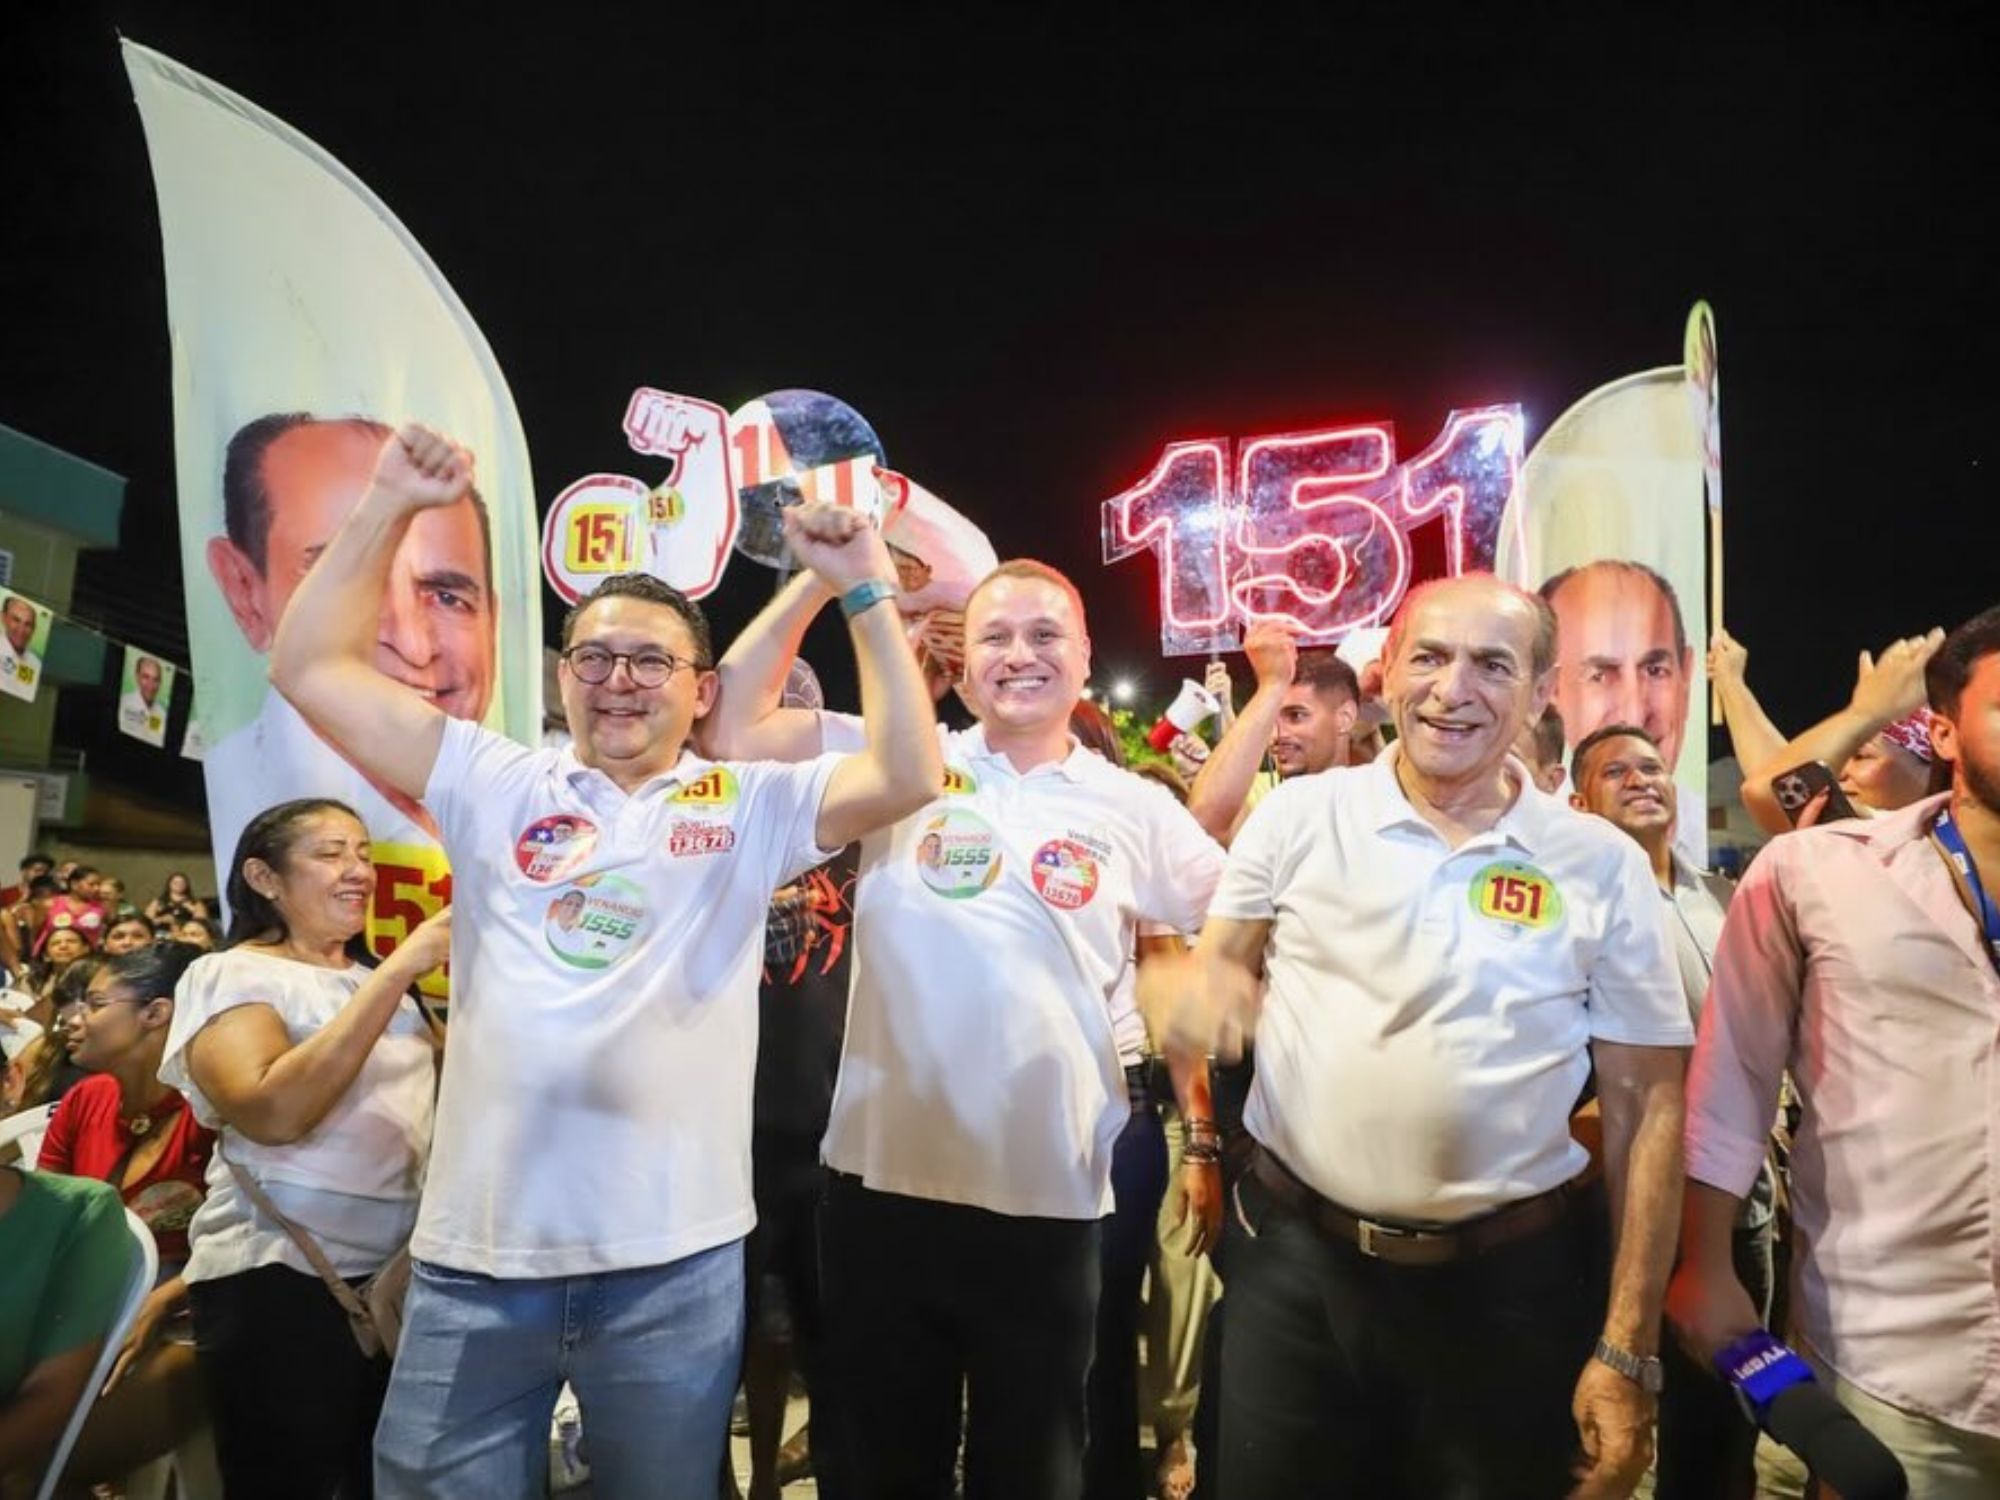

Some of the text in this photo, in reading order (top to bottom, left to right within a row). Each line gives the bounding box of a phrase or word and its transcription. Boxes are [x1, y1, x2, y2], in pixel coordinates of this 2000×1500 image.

[574, 513, 634, 563] 151
[1122, 410, 1528, 636] 151
[944, 848, 991, 866] 1555
[1491, 876, 1541, 920] 151
[577, 912, 637, 940] 1555
